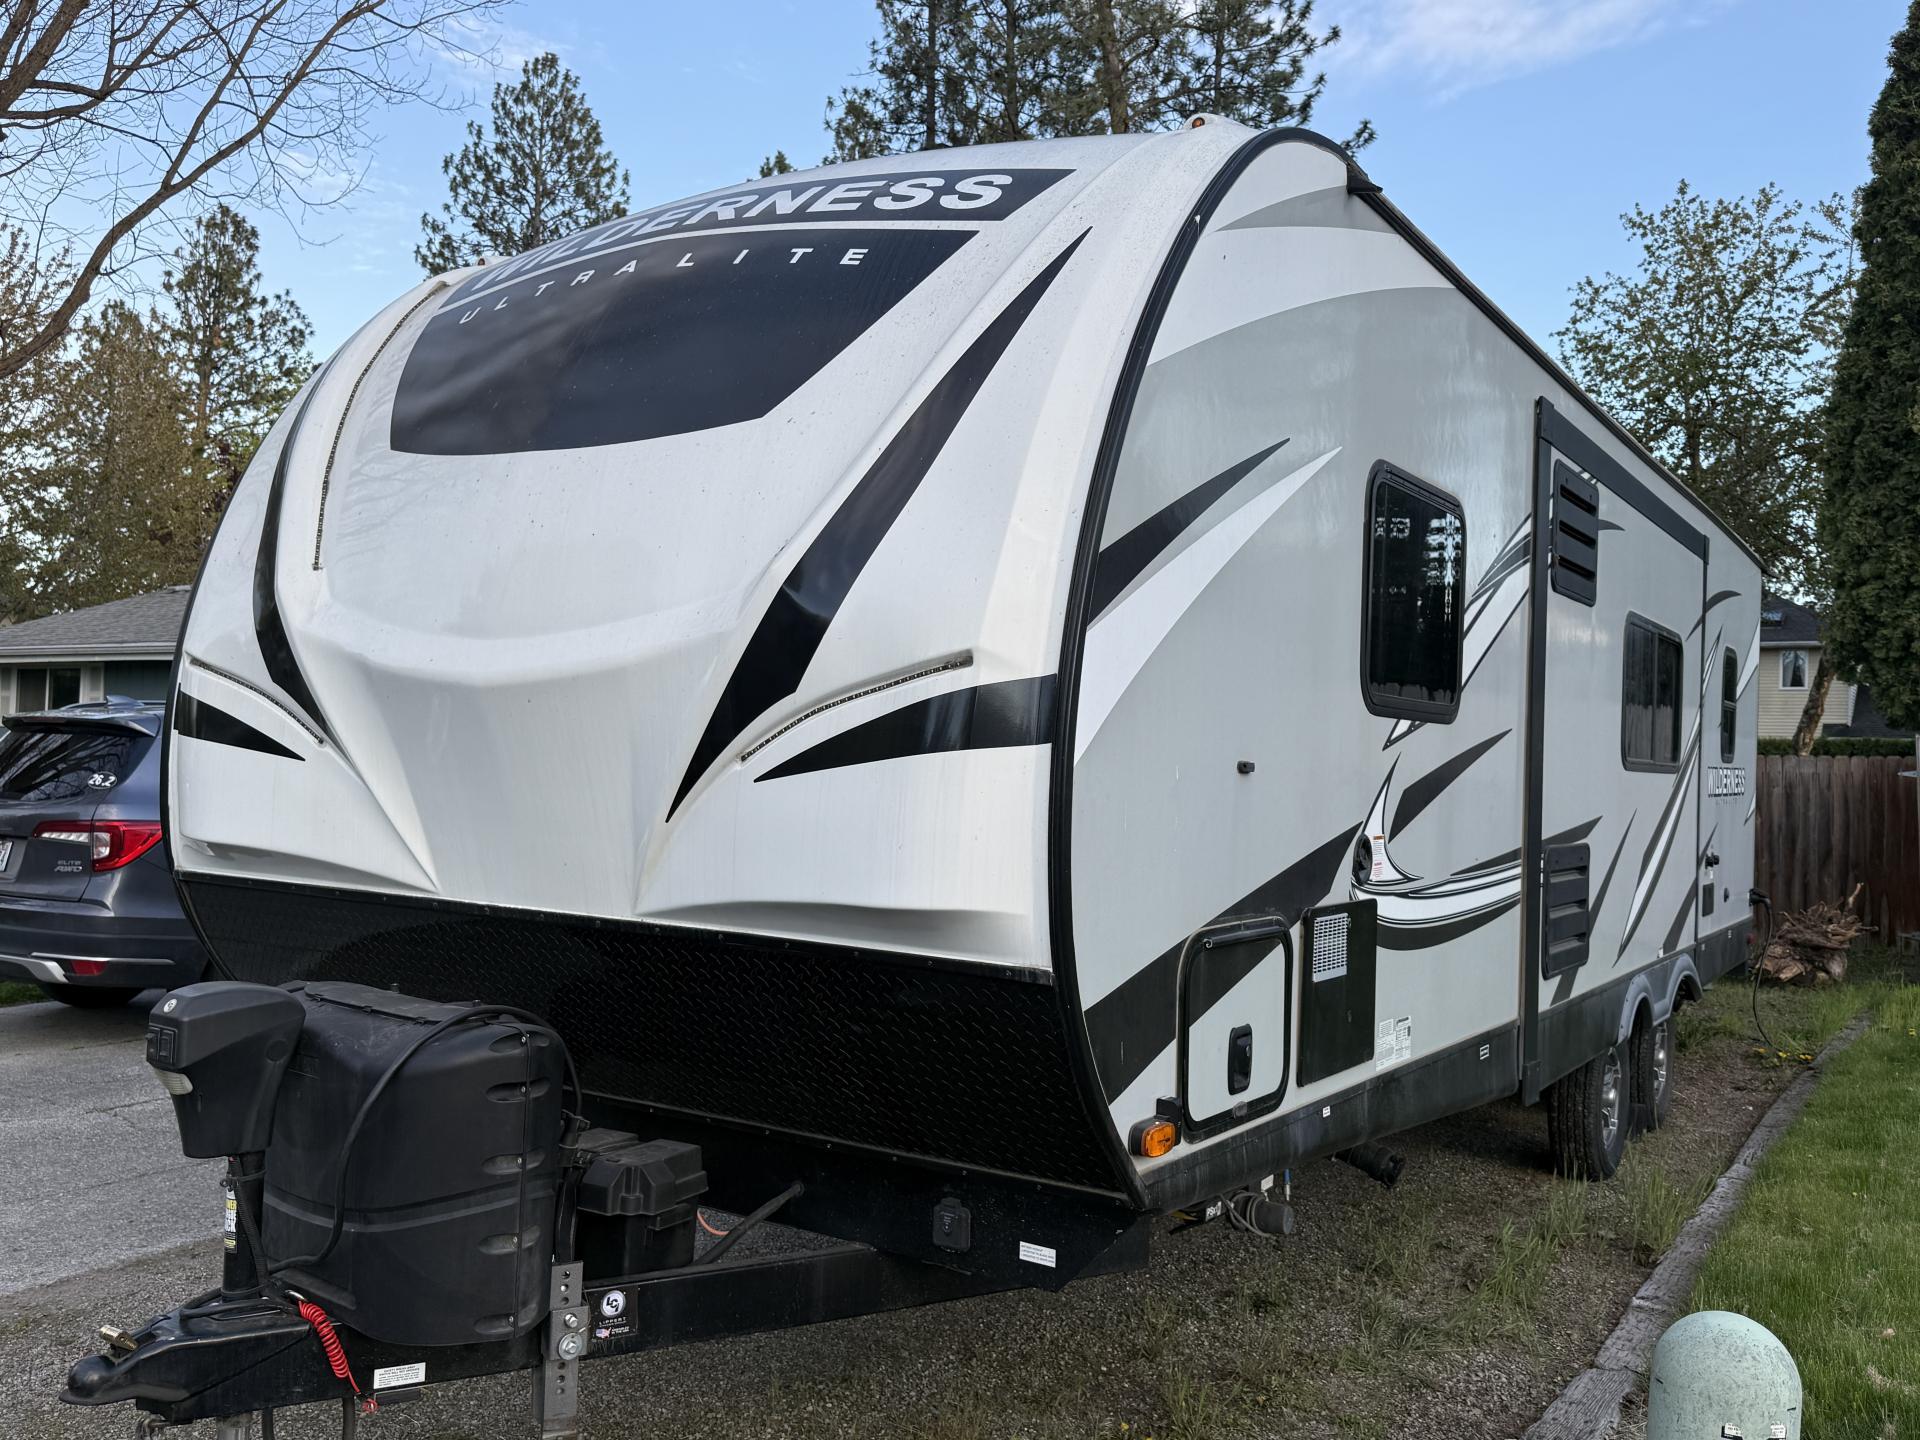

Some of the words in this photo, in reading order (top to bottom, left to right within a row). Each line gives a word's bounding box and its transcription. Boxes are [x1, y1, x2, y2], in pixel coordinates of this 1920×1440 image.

[471, 174, 1013, 292] WILDERNESS
[88, 773, 116, 787] 26.2
[1707, 766, 1746, 798] WILDERNESS
